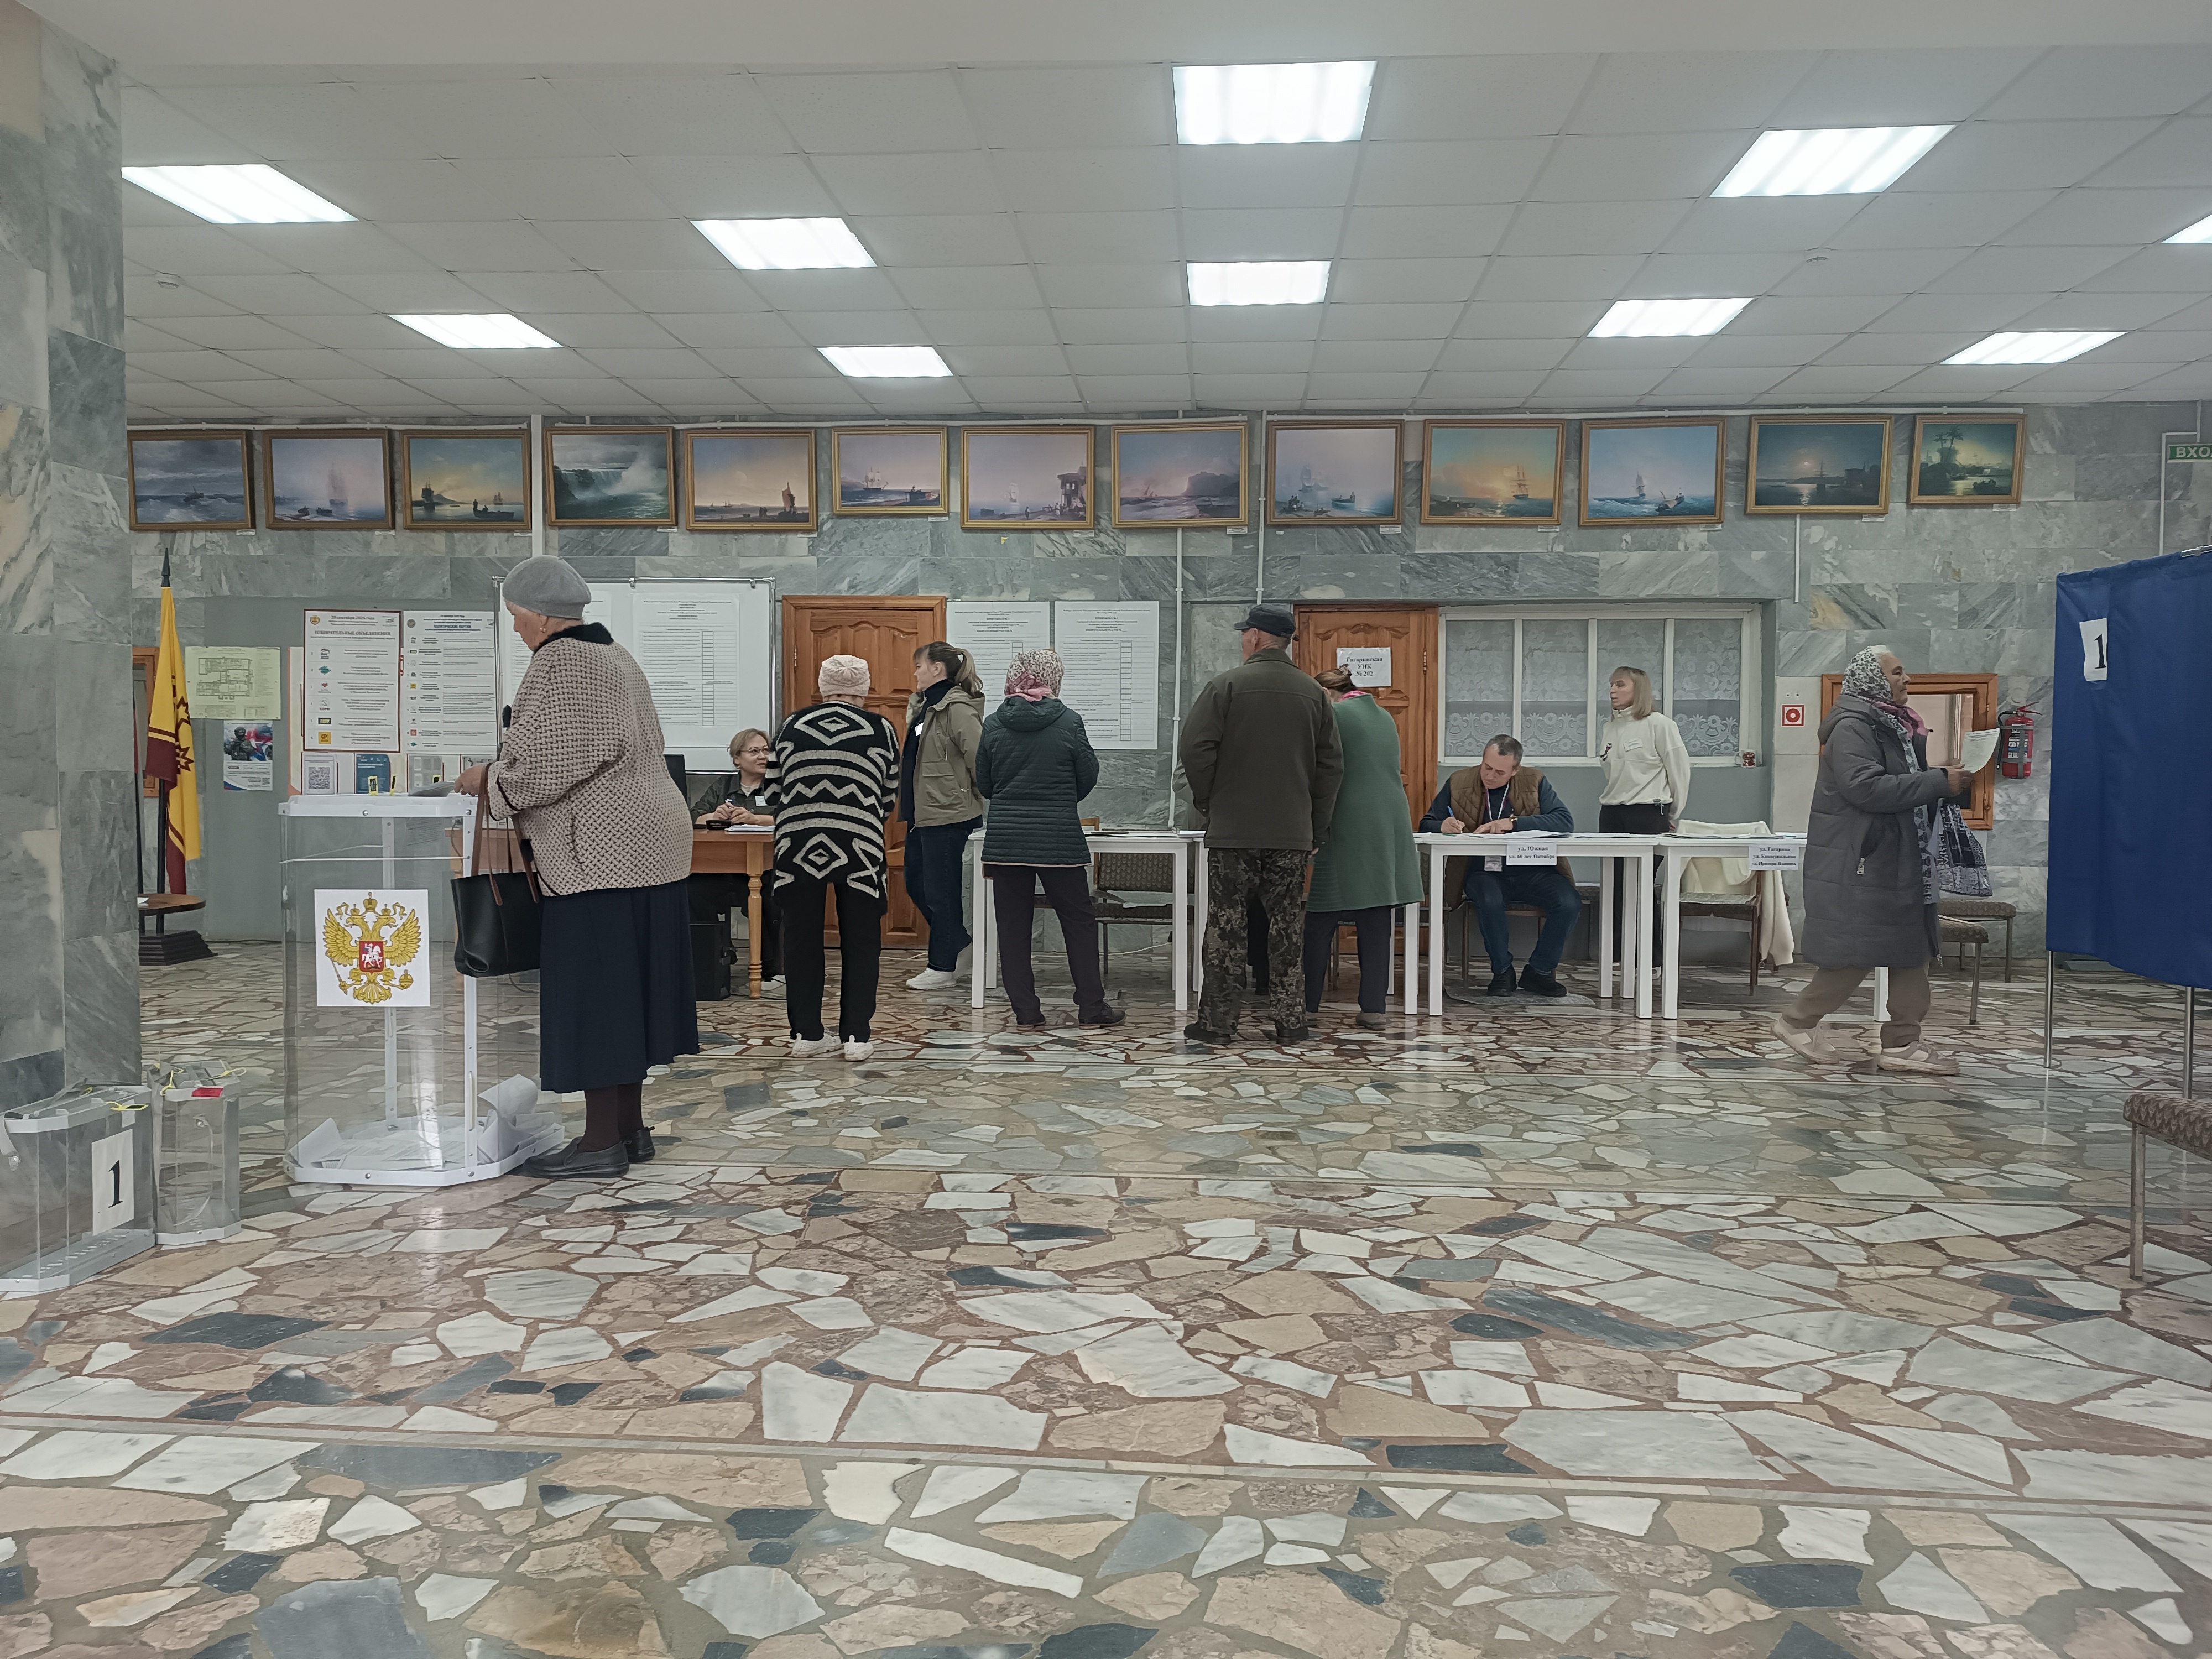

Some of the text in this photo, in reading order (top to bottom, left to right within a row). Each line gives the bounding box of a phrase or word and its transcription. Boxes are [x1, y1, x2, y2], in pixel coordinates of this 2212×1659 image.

[2176, 446, 2212, 458] ВХО
[2094, 633, 2106, 669] 1
[108, 1160, 123, 1209] 1
